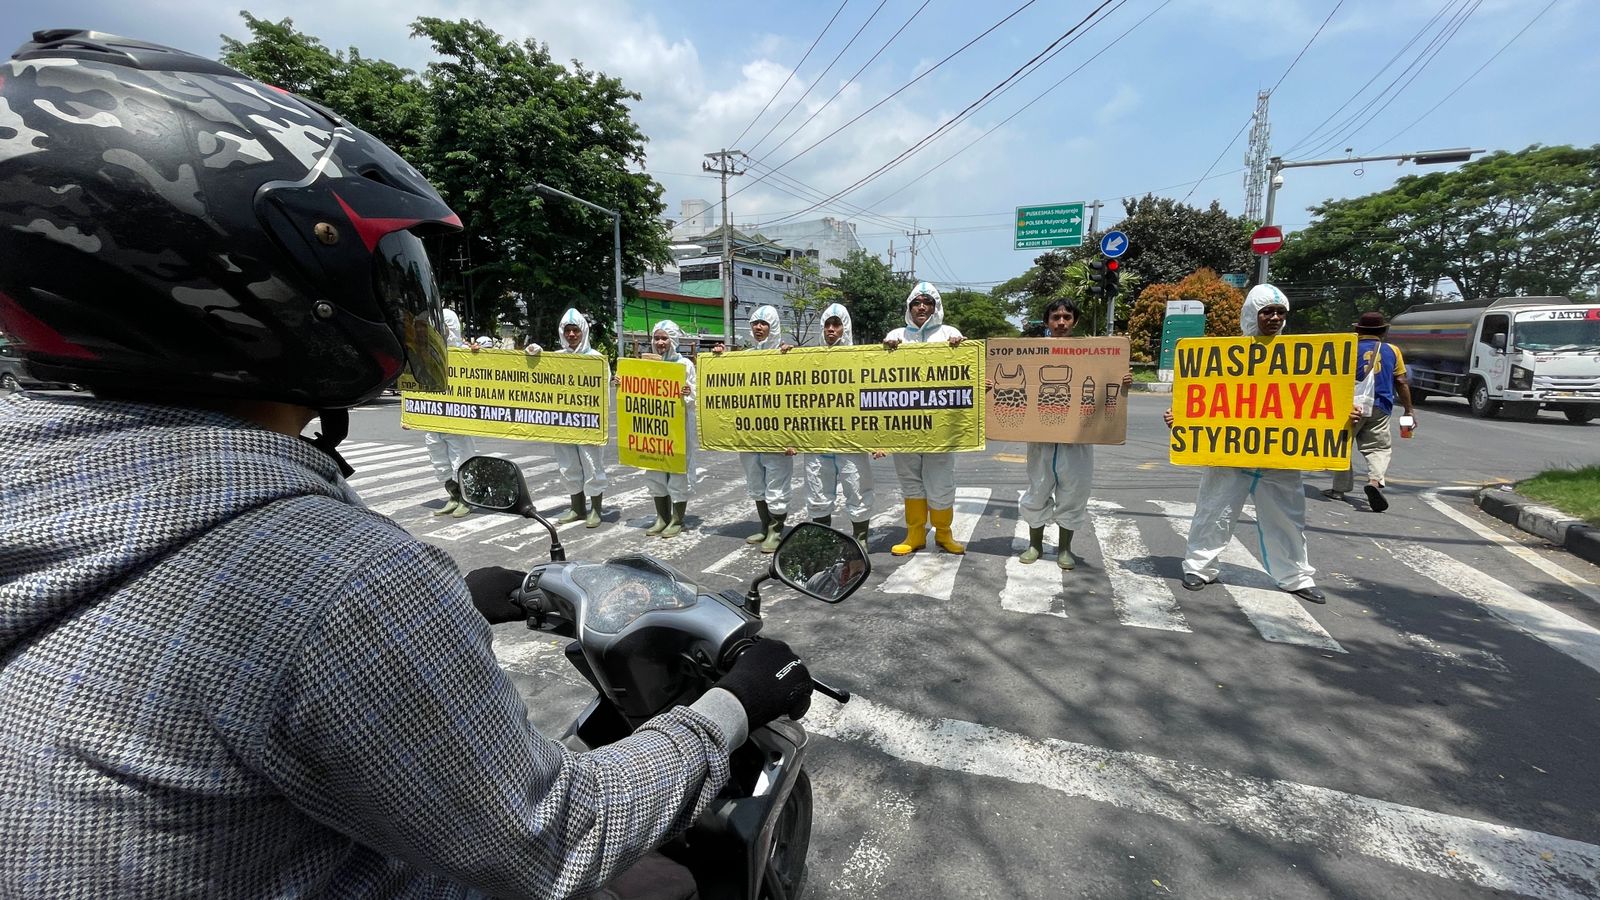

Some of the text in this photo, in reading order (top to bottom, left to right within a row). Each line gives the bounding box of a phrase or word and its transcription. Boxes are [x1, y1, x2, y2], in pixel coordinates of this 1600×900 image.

[990, 347, 1121, 356] STOP BANJIR MIKROPLASTIK
[1178, 341, 1352, 378] WASPADAI
[460, 368, 494, 381] PLASTIK
[494, 369, 529, 383] BANJIRI
[531, 371, 566, 386] SUNGAI
[568, 374, 575, 387] &
[577, 375, 602, 388] LAUT
[621, 376, 681, 399] INDONESIA
[706, 364, 971, 388] MINUM AIR DARI BOTOL PLASTIK AMDK
[456, 386, 472, 398] AIR
[474, 386, 505, 400] DALAM
[508, 389, 553, 404] KEMASAN
[556, 393, 600, 407] PLASTIK
[625, 395, 676, 418] DARURAT
[705, 388, 972, 410] MEMBUATMU TERPAPAR MIKROPLASTIK
[1185, 382, 1334, 420] BAHAYA
[405, 398, 600, 428] BRANTAS MBOIS TANPA MIKROPLASTIK
[735, 414, 933, 432] 90.000 PARTIKEL PER TAHUN
[632, 416, 669, 437] MIKRO
[628, 434, 675, 457] PLASTIK
[1171, 425, 1349, 459] STYROFOAM
